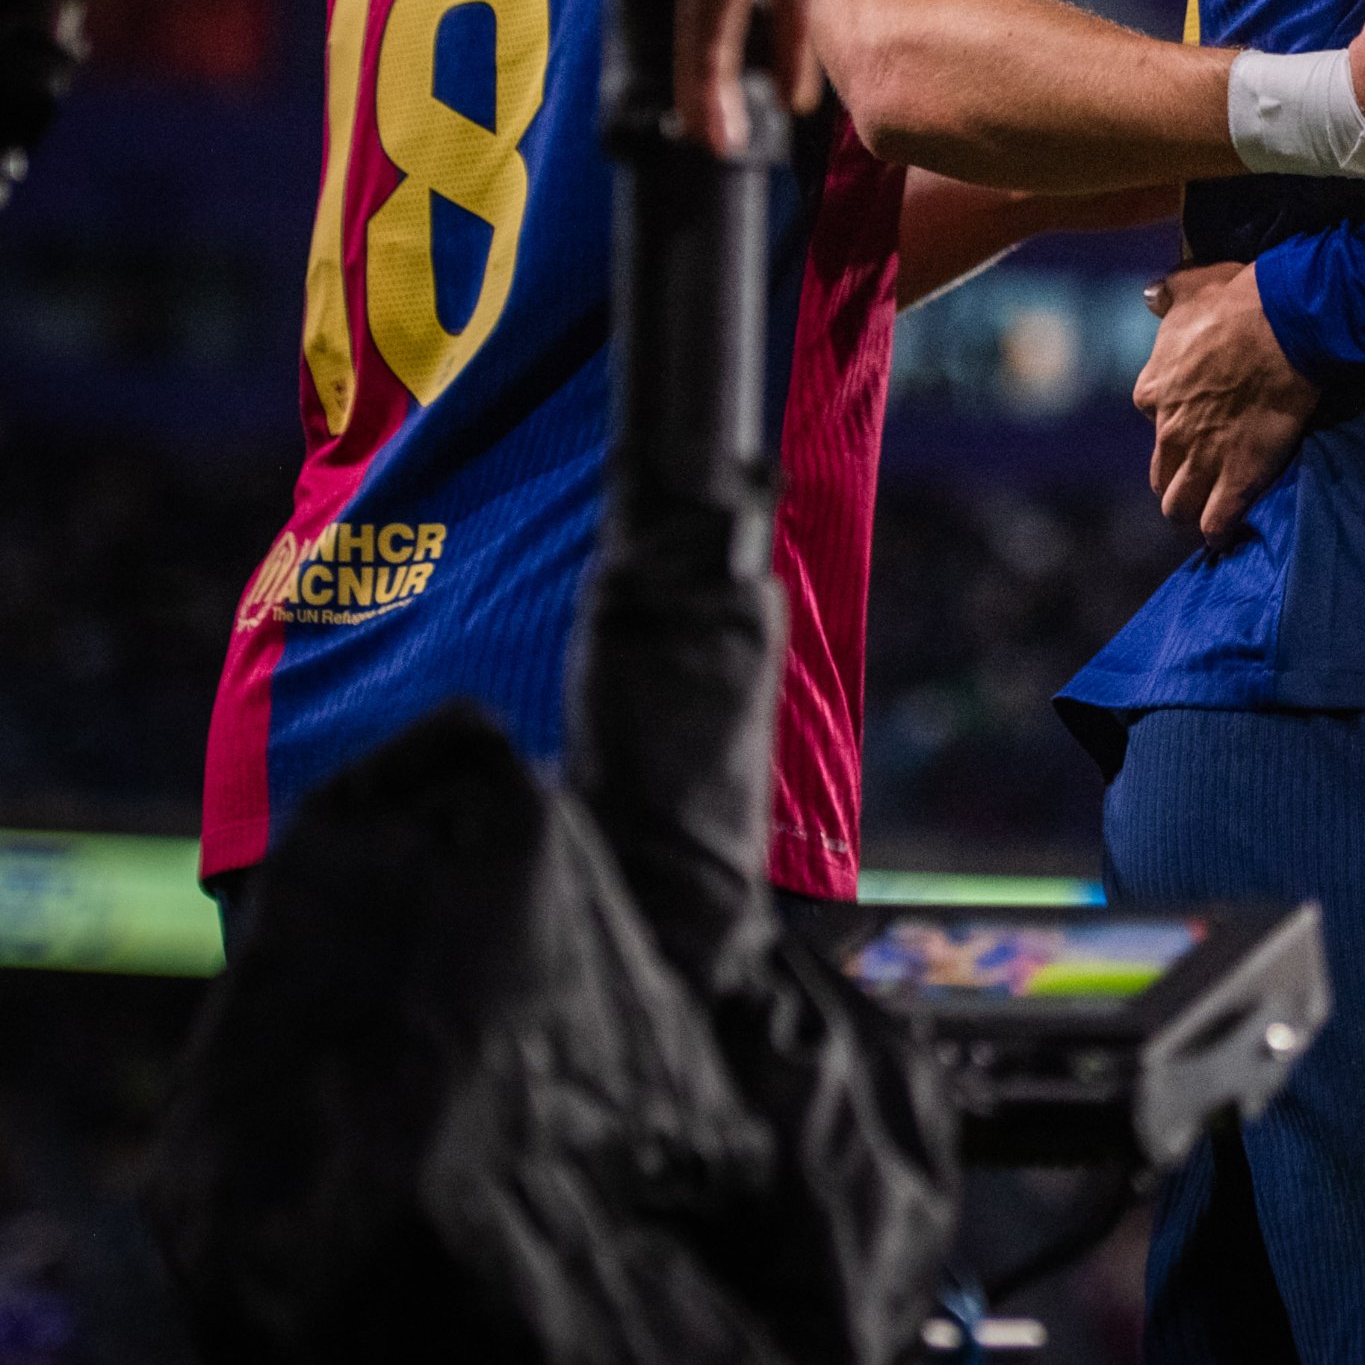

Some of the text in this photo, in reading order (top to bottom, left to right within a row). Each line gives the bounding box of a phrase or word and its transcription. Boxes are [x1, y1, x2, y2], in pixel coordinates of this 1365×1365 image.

[300, 522, 447, 563] NHCR
[277, 562, 435, 607] ACNUR
[272, 606, 294, 622] The
[295, 608, 320, 624] UN
